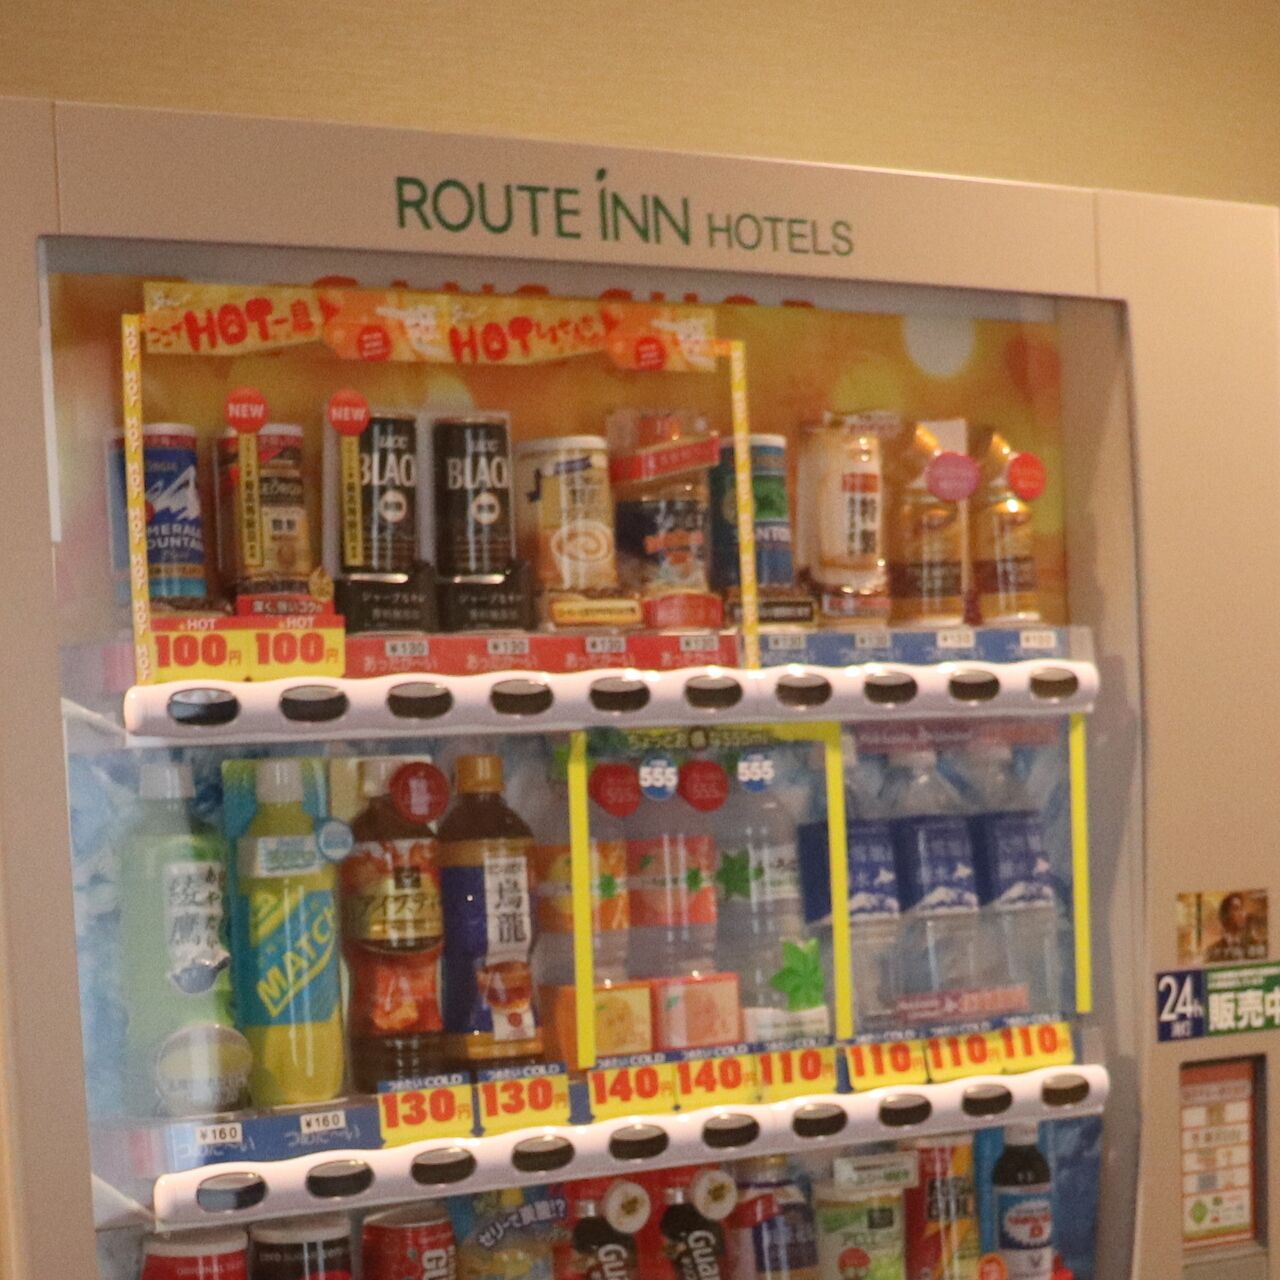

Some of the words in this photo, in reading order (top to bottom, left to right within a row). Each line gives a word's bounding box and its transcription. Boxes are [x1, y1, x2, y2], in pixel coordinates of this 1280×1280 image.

[395, 175, 581, 240] ROUTE
[707, 212, 854, 257] HOTELS
[228, 401, 265, 419] NEW
[330, 406, 367, 423] NEW
